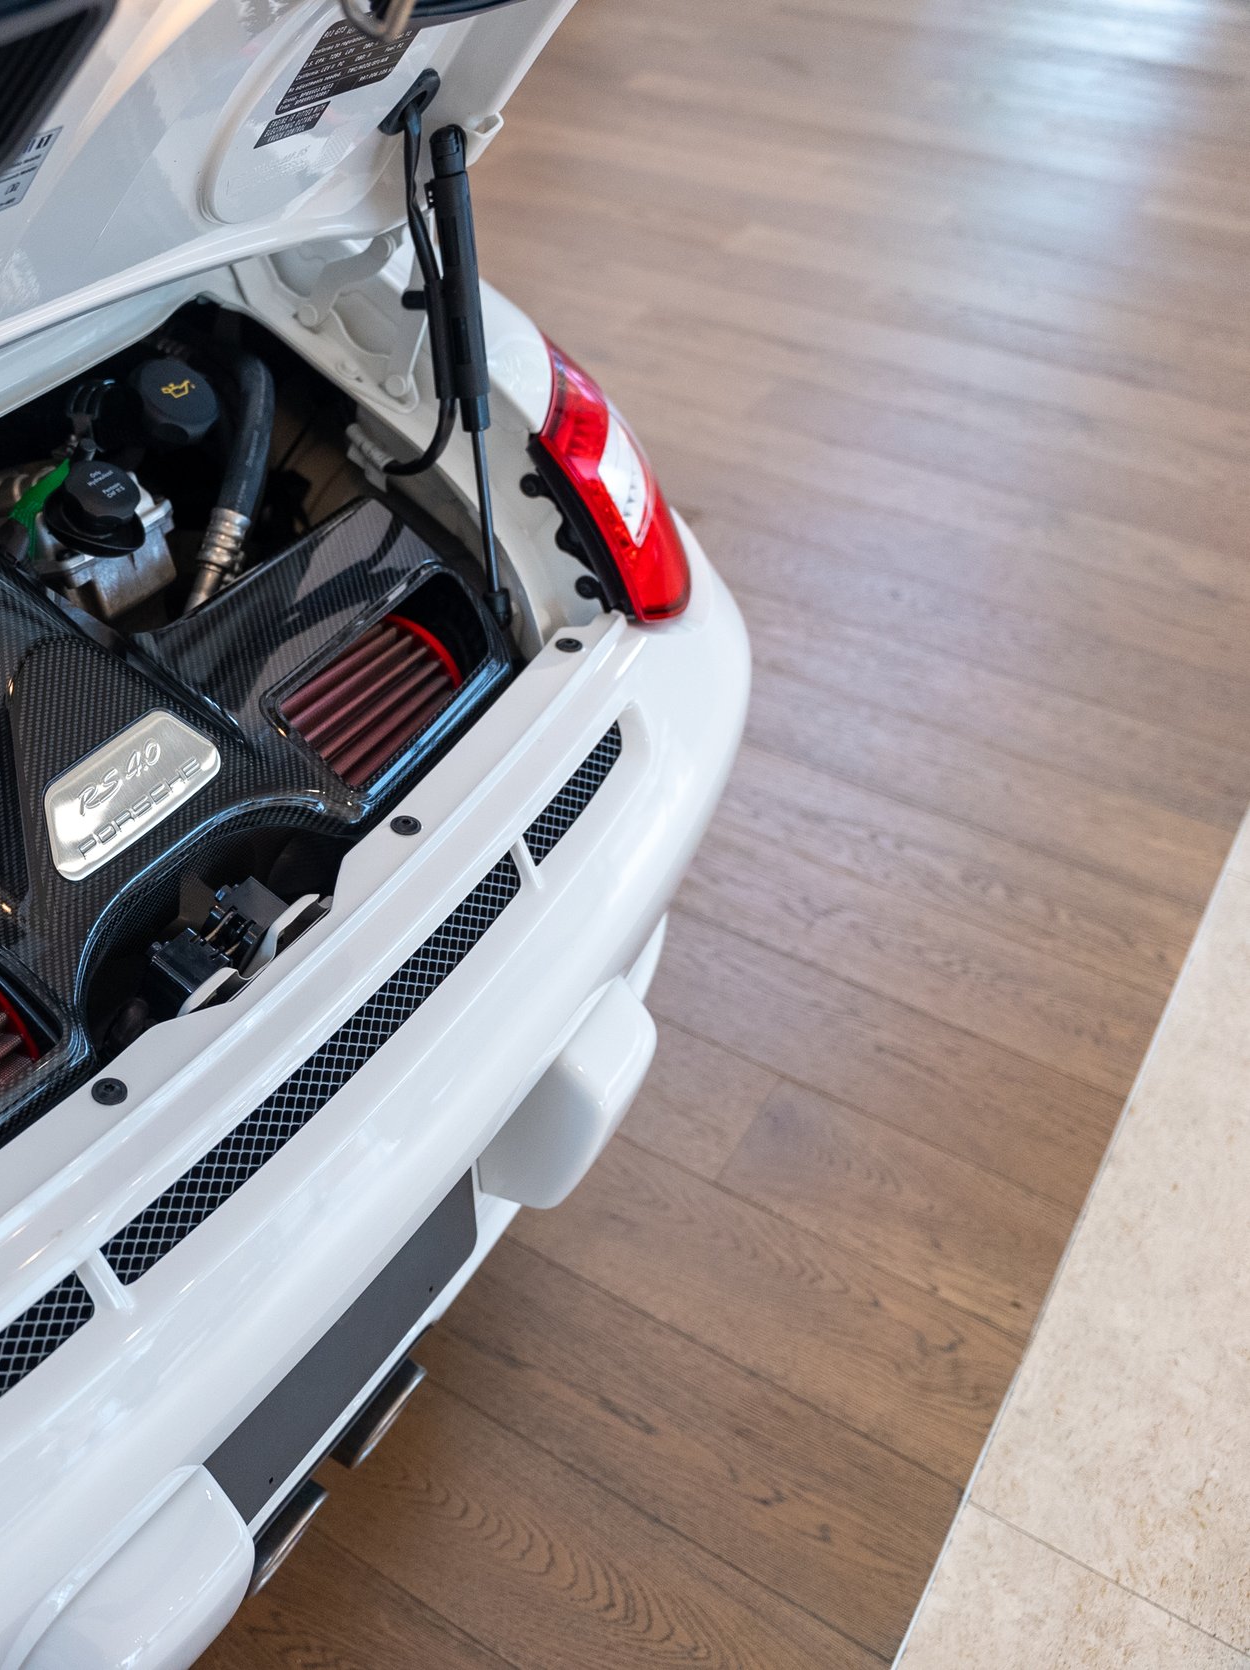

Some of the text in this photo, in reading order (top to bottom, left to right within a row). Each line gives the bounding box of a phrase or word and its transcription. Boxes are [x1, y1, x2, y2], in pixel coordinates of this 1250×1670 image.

[77, 738, 161, 816] RS 4.0
[78, 756, 201, 861] PORSCHE
